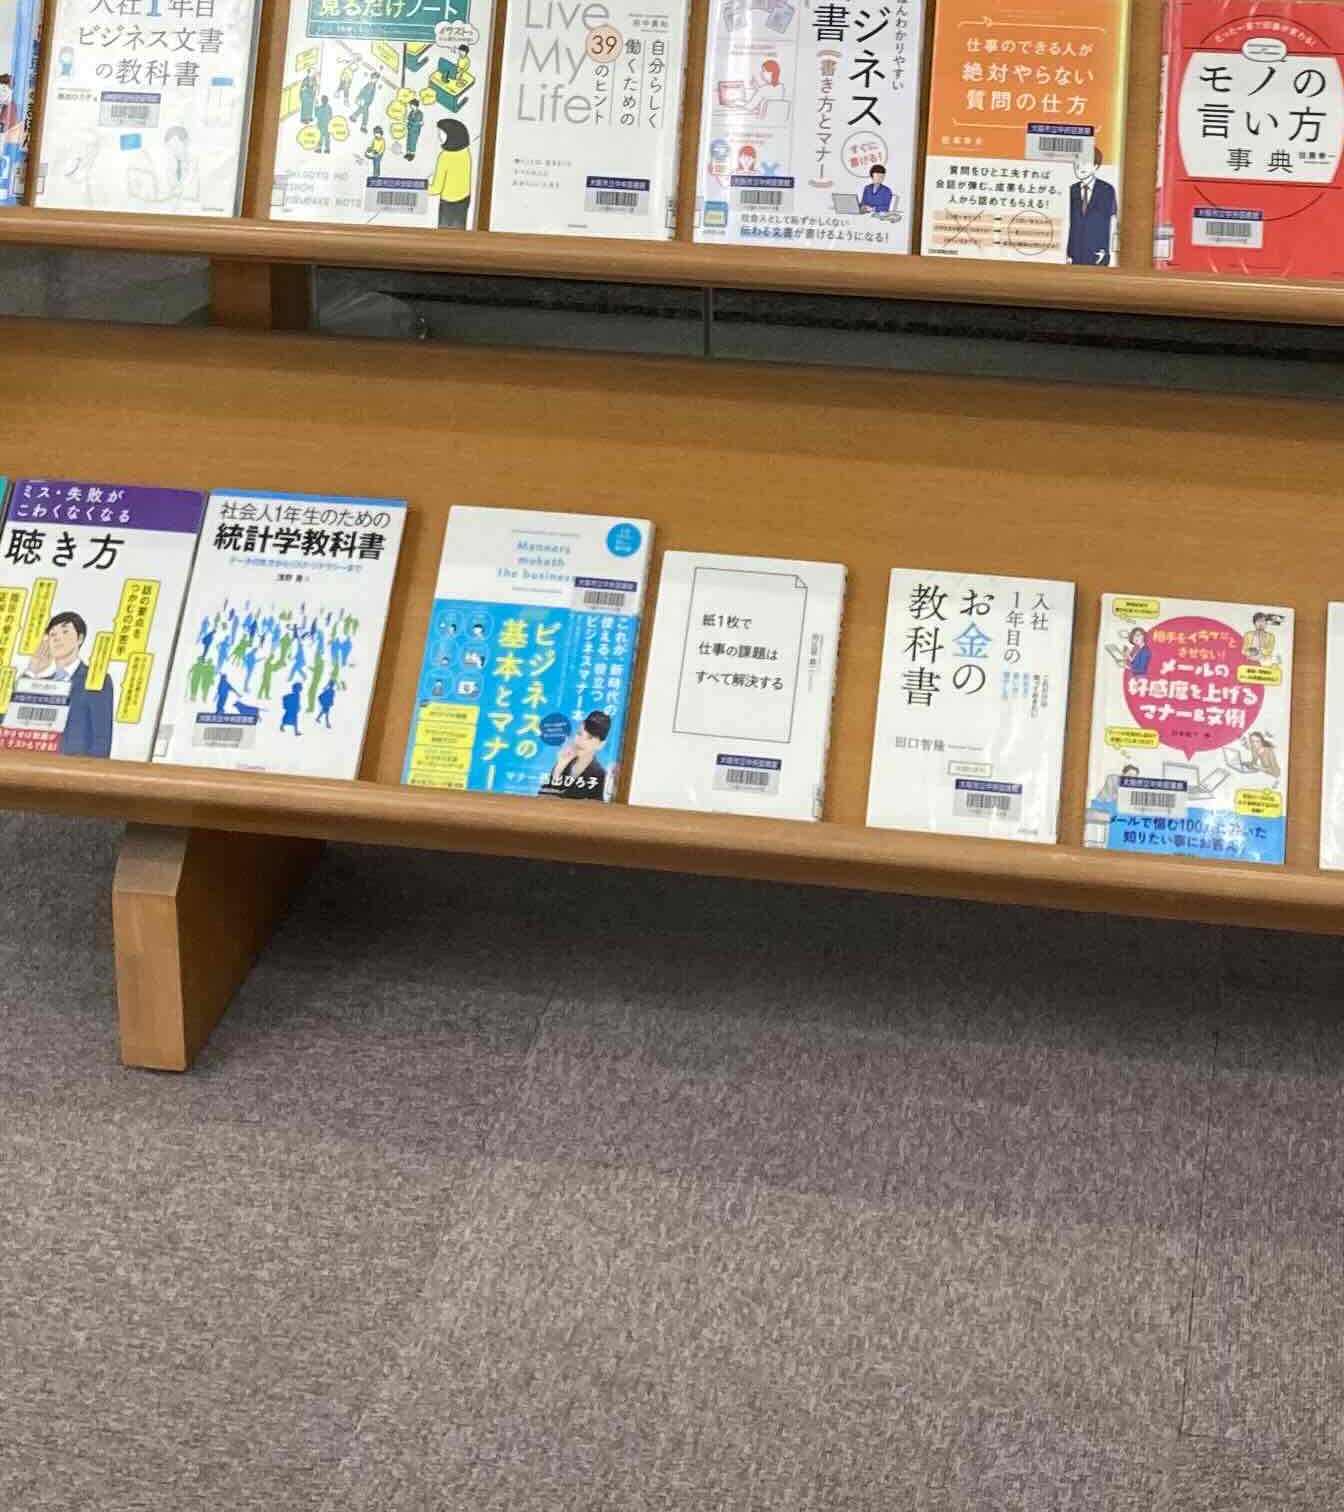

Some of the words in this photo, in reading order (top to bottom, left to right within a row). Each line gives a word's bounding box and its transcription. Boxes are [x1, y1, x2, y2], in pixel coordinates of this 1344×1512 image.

[78, 25, 226, 55] ビジネス文書
[966, 38, 1094, 57] 仕事のできる人が
[95, 58, 201, 88] の教科書
[519, 39, 588, 84] My
[961, 62, 1094, 86] 絶対やらない
[620, 39, 642, 127] 働くための
[648, 39, 666, 129] 自分らしく
[1199, 66, 1326, 97] モノの
[517, 82, 593, 125] Life
[965, 89, 1088, 115] 質問の仕方
[1196, 103, 1328, 143] 言い方
[1226, 147, 1295, 174] 事典
[22, 485, 125, 503] ミス・失敗が
[17, 504, 131, 524] こわくなくなる
[220, 501, 391, 529] 社会人1年生のための
[5, 528, 126, 570] 聴き方
[213, 523, 388, 561] 統計学教科書
[702, 613, 753, 630] 紙1枚で
[1030, 592, 1050, 632] 入社
[952, 589, 995, 696] お金の
[1003, 591, 1025, 665] 1年目の
[698, 642, 779, 662] 仕事の課題は
[901, 583, 949, 707] 教科書
[695, 670, 785, 691] すべて解決する
[1160, 659, 1231, 678] メールの
[481, 619, 529, 792] 基本とマナー
[515, 622, 561, 759] ビジネスの
[1127, 677, 1258, 706] 好感度を上げる
[1139, 703, 1247, 729] マナー&文例
